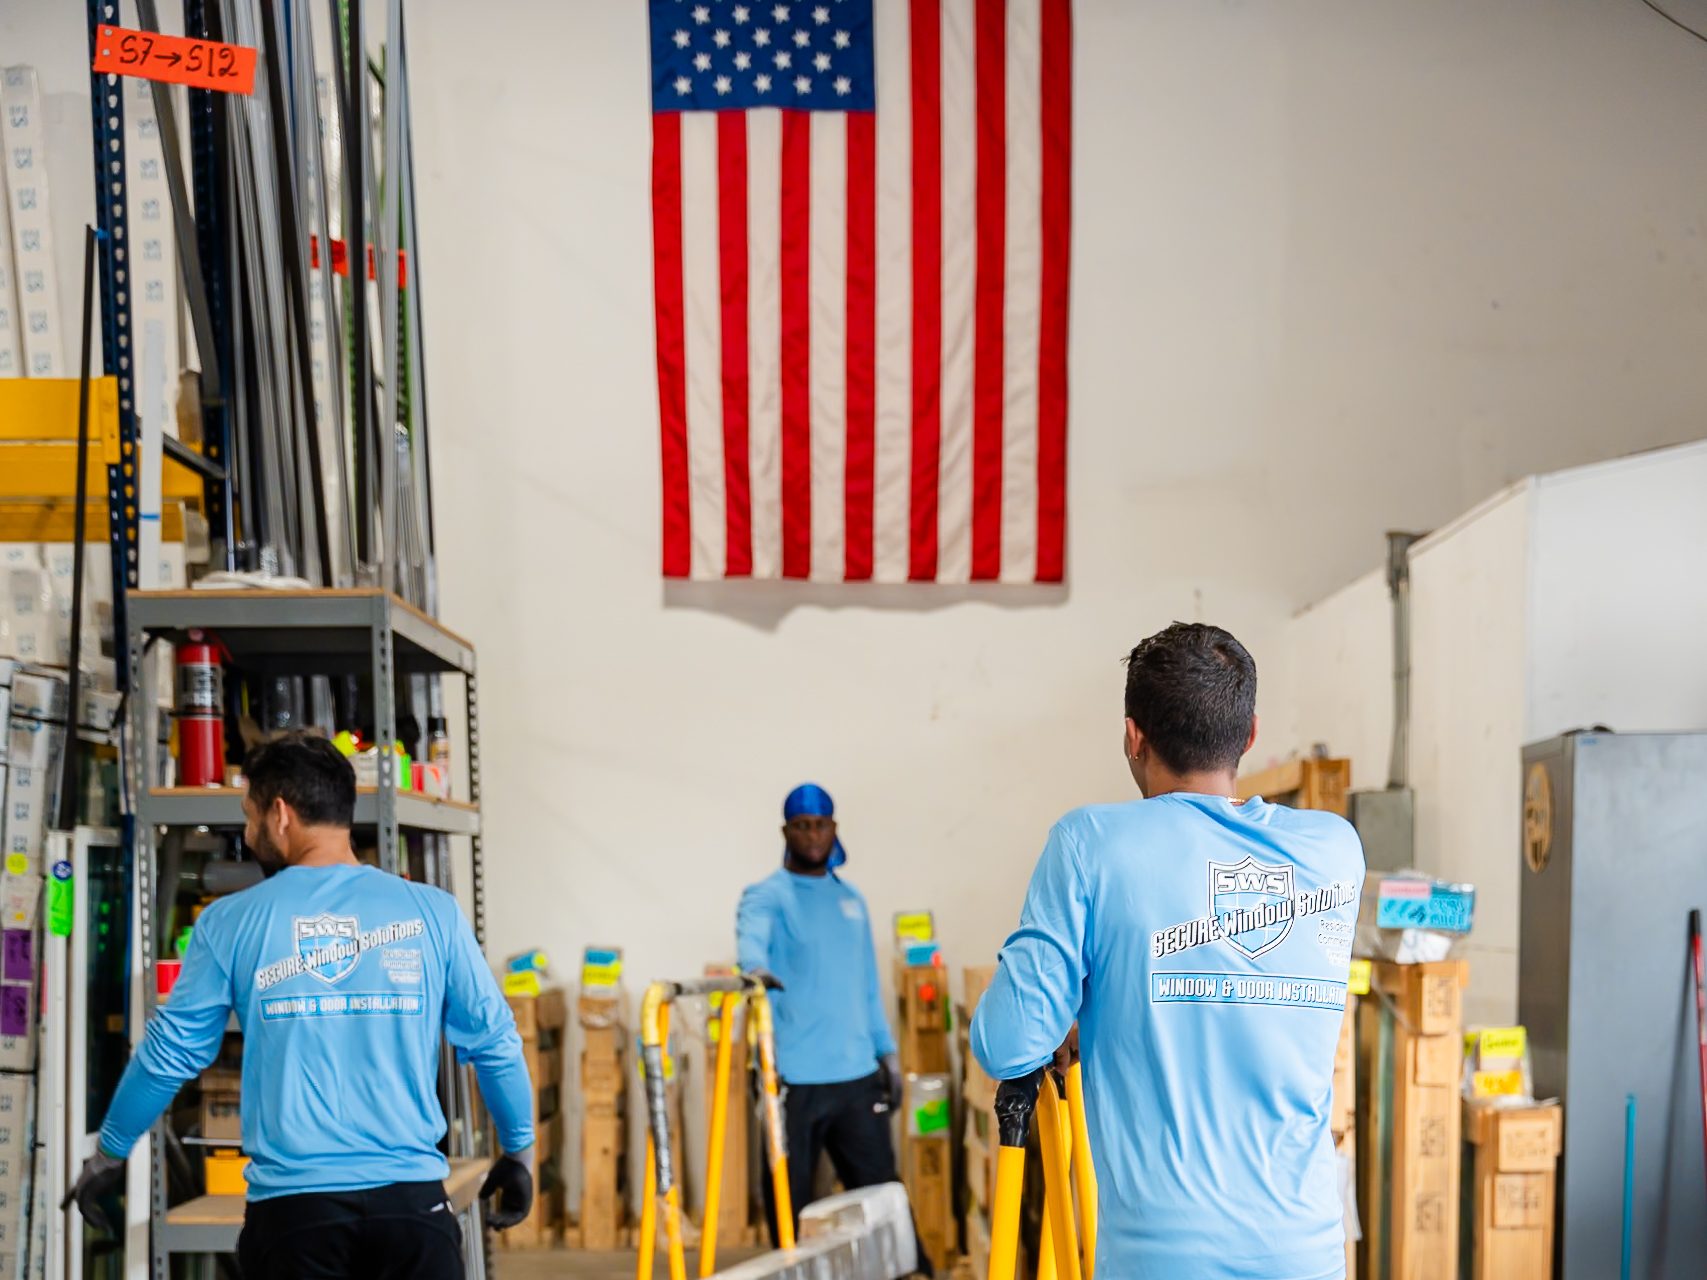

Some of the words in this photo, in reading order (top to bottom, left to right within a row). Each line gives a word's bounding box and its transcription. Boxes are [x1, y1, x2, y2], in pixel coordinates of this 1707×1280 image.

[120, 35, 154, 66] S7
[186, 45, 239, 78] S12
[1217, 872, 1286, 894] SWS
[300, 922, 353, 937] SWS
[1153, 916, 1219, 957] SECURE
[1224, 900, 1294, 937] Window
[257, 955, 305, 990] SECURE
[305, 938, 360, 970] Window
[361, 920, 424, 950] Solutions
[1160, 978, 1217, 997] WINDOW
[1222, 980, 1233, 997] &
[1238, 980, 1274, 999] DOOR
[266, 999, 306, 1015] WINDOW
[320, 998, 347, 1012] DOOR
[350, 998, 419, 1012] INSTALLATION
